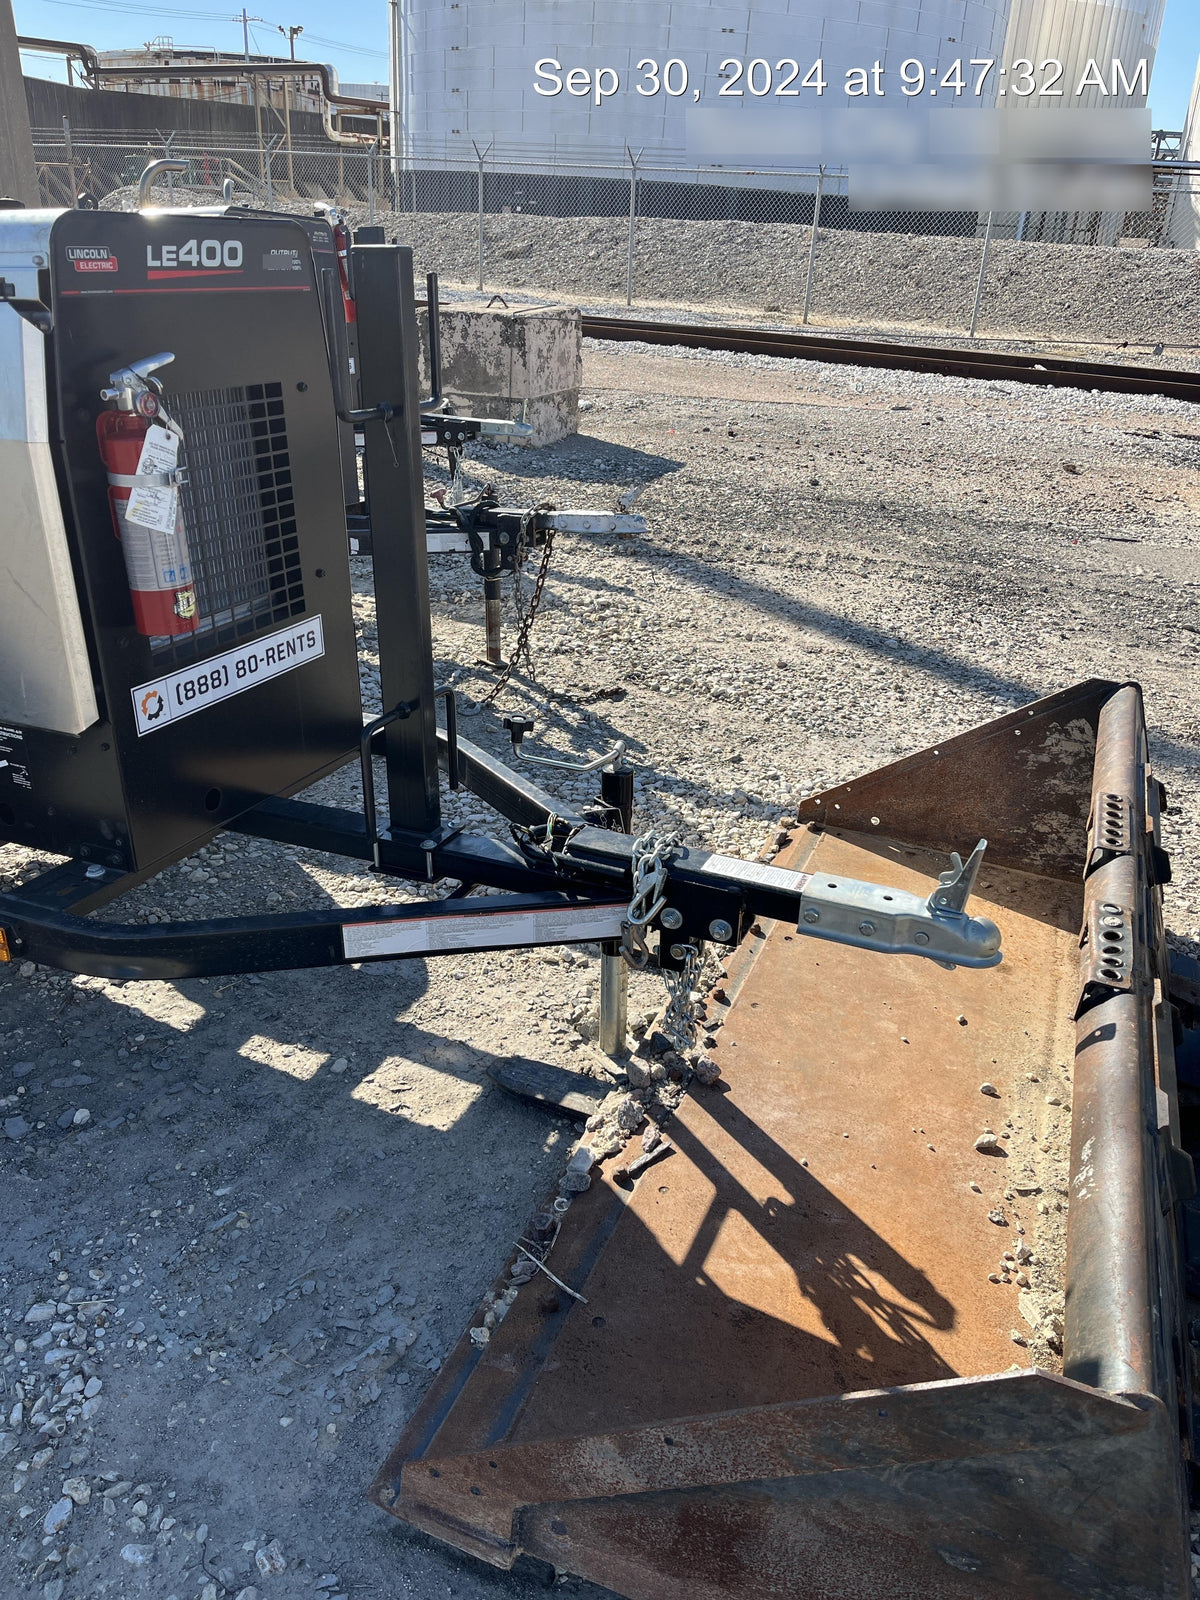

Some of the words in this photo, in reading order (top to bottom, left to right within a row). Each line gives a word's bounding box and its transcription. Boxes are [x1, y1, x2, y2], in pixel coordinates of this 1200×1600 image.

[68, 249, 108, 259] LINCOLN
[146, 239, 243, 268] LE400
[79, 261, 114, 269] ELECTRIC
[175, 665, 230, 706] (888)
[235, 630, 317, 679] 80-RENTS
